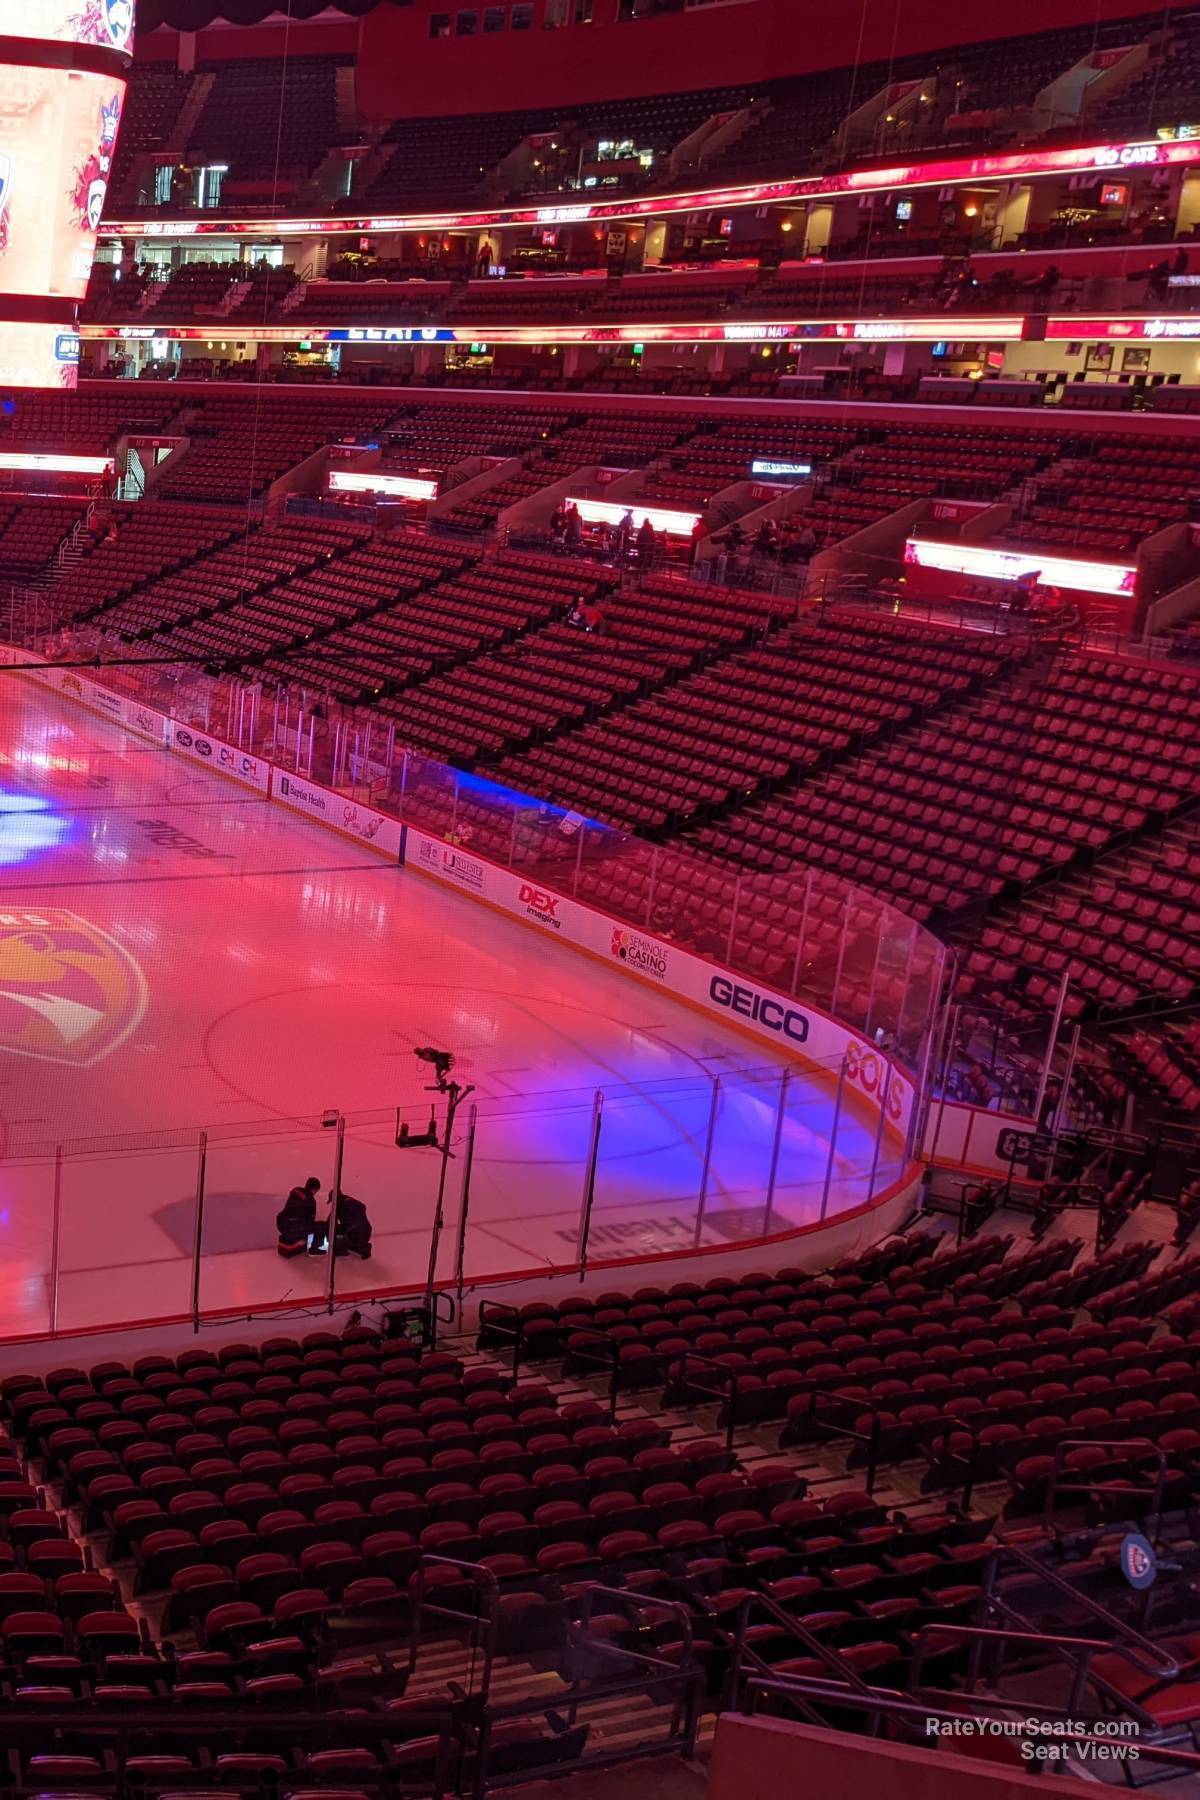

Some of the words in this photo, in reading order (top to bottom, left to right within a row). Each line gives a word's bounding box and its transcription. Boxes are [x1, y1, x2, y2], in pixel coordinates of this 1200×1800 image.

[1120, 146, 1157, 163] CATS
[290, 784, 308, 801] Baptist
[308, 792, 326, 810] Health
[518, 884, 559, 917] DEX
[526, 905, 561, 929] imaging
[628, 946, 667, 973] CASINO
[629, 934, 669, 962] SEMINOLE
[709, 975, 810, 1044] GEICO
